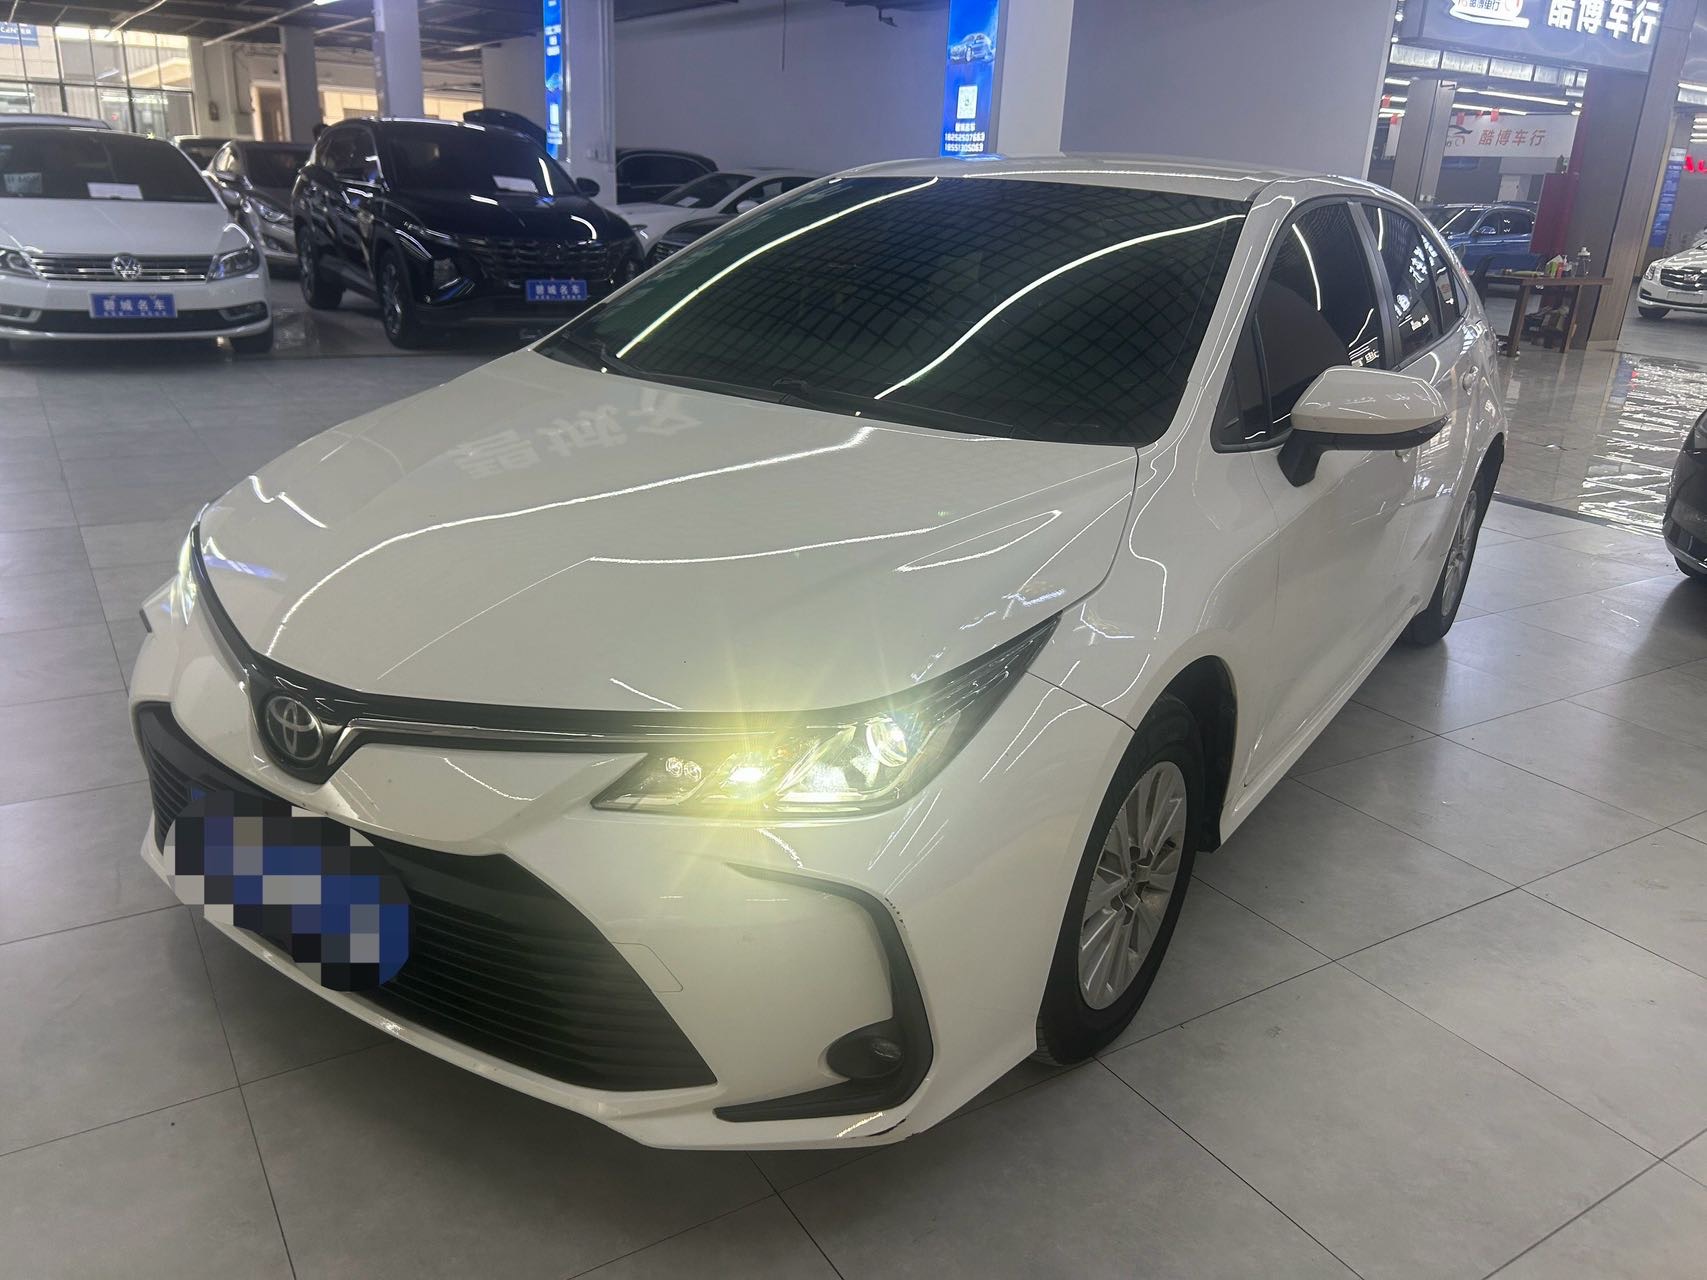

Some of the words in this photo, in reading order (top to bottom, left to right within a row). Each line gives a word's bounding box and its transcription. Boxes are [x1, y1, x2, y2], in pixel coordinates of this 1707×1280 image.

[1547, 0, 1662, 45] 酷博车行
[1478, 128, 1547, 147] 酷博车行
